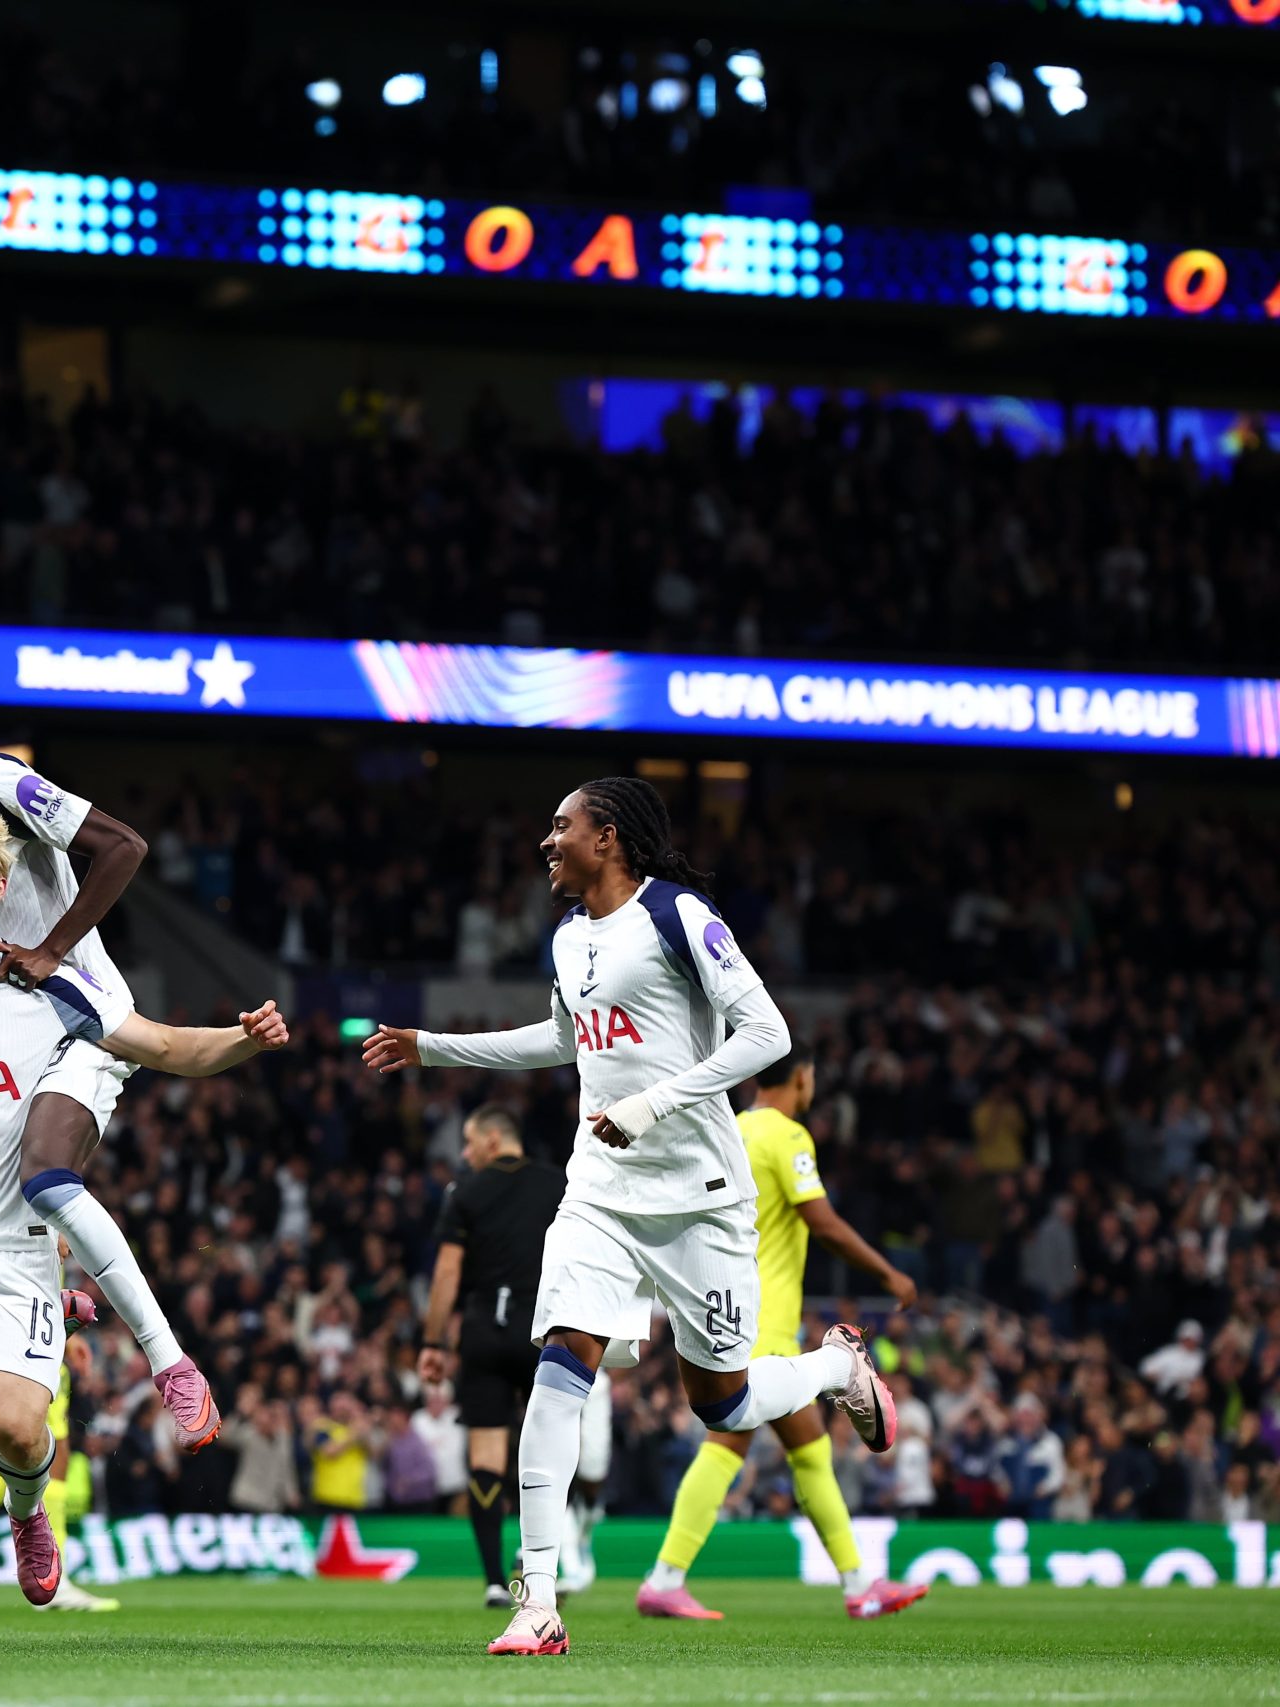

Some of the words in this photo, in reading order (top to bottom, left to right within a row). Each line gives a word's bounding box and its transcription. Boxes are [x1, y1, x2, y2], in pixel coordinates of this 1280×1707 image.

[668, 672, 780, 721] UEFA
[781, 675, 1034, 732] CHAMPIONS
[1036, 687, 1198, 738] LEAGUE
[574, 1005, 644, 1051] AIA
[30, 1297, 54, 1346] 15
[706, 1290, 741, 1335] 24
